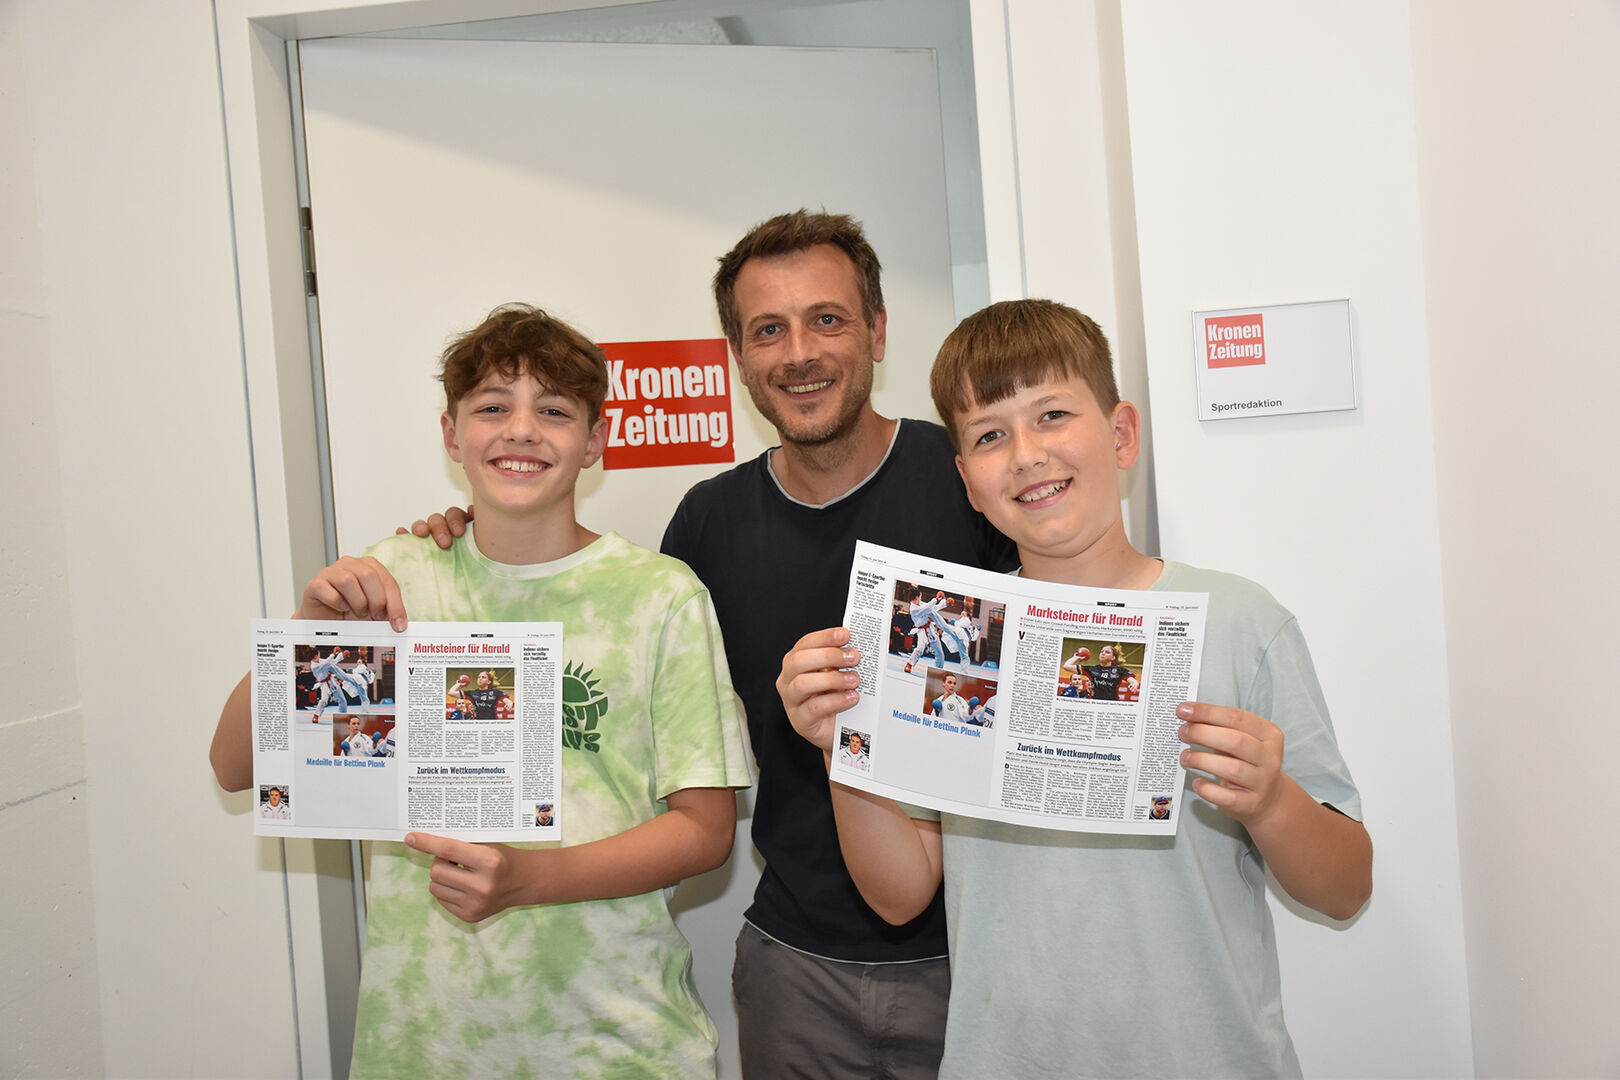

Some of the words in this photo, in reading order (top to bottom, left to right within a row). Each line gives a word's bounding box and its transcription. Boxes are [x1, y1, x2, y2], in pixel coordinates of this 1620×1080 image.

[1207, 324, 1261, 342] Kronen
[1208, 342, 1263, 360] Zeitung
[605, 360, 726, 401] Kronen
[1211, 399, 1282, 412] Sportredaktion
[605, 404, 729, 448] Zeitung
[1027, 604, 1090, 623] Marksteiner
[1092, 612, 1106, 625] für
[1109, 614, 1143, 627] Harald
[414, 643, 466, 653] Marksteiner
[468, 643, 480, 653] für
[482, 643, 510, 653] Harald
[892, 709, 921, 724] Medaille
[922, 717, 932, 727] für
[934, 719, 959, 734] Bettina
[960, 725, 981, 738] Plank
[1017, 742, 1043, 754] Zurück
[1044, 746, 1054, 755] im
[1056, 747, 1121, 761] Wettkampfmodus
[306, 758, 332, 767] Medaille
[334, 758, 342, 766] für
[344, 759, 366, 768] Bettina
[367, 760, 385, 768] Plank
[417, 766, 438, 774] Zurück
[440, 766, 448, 774] im
[450, 766, 506, 775] Wettkampfmodus
